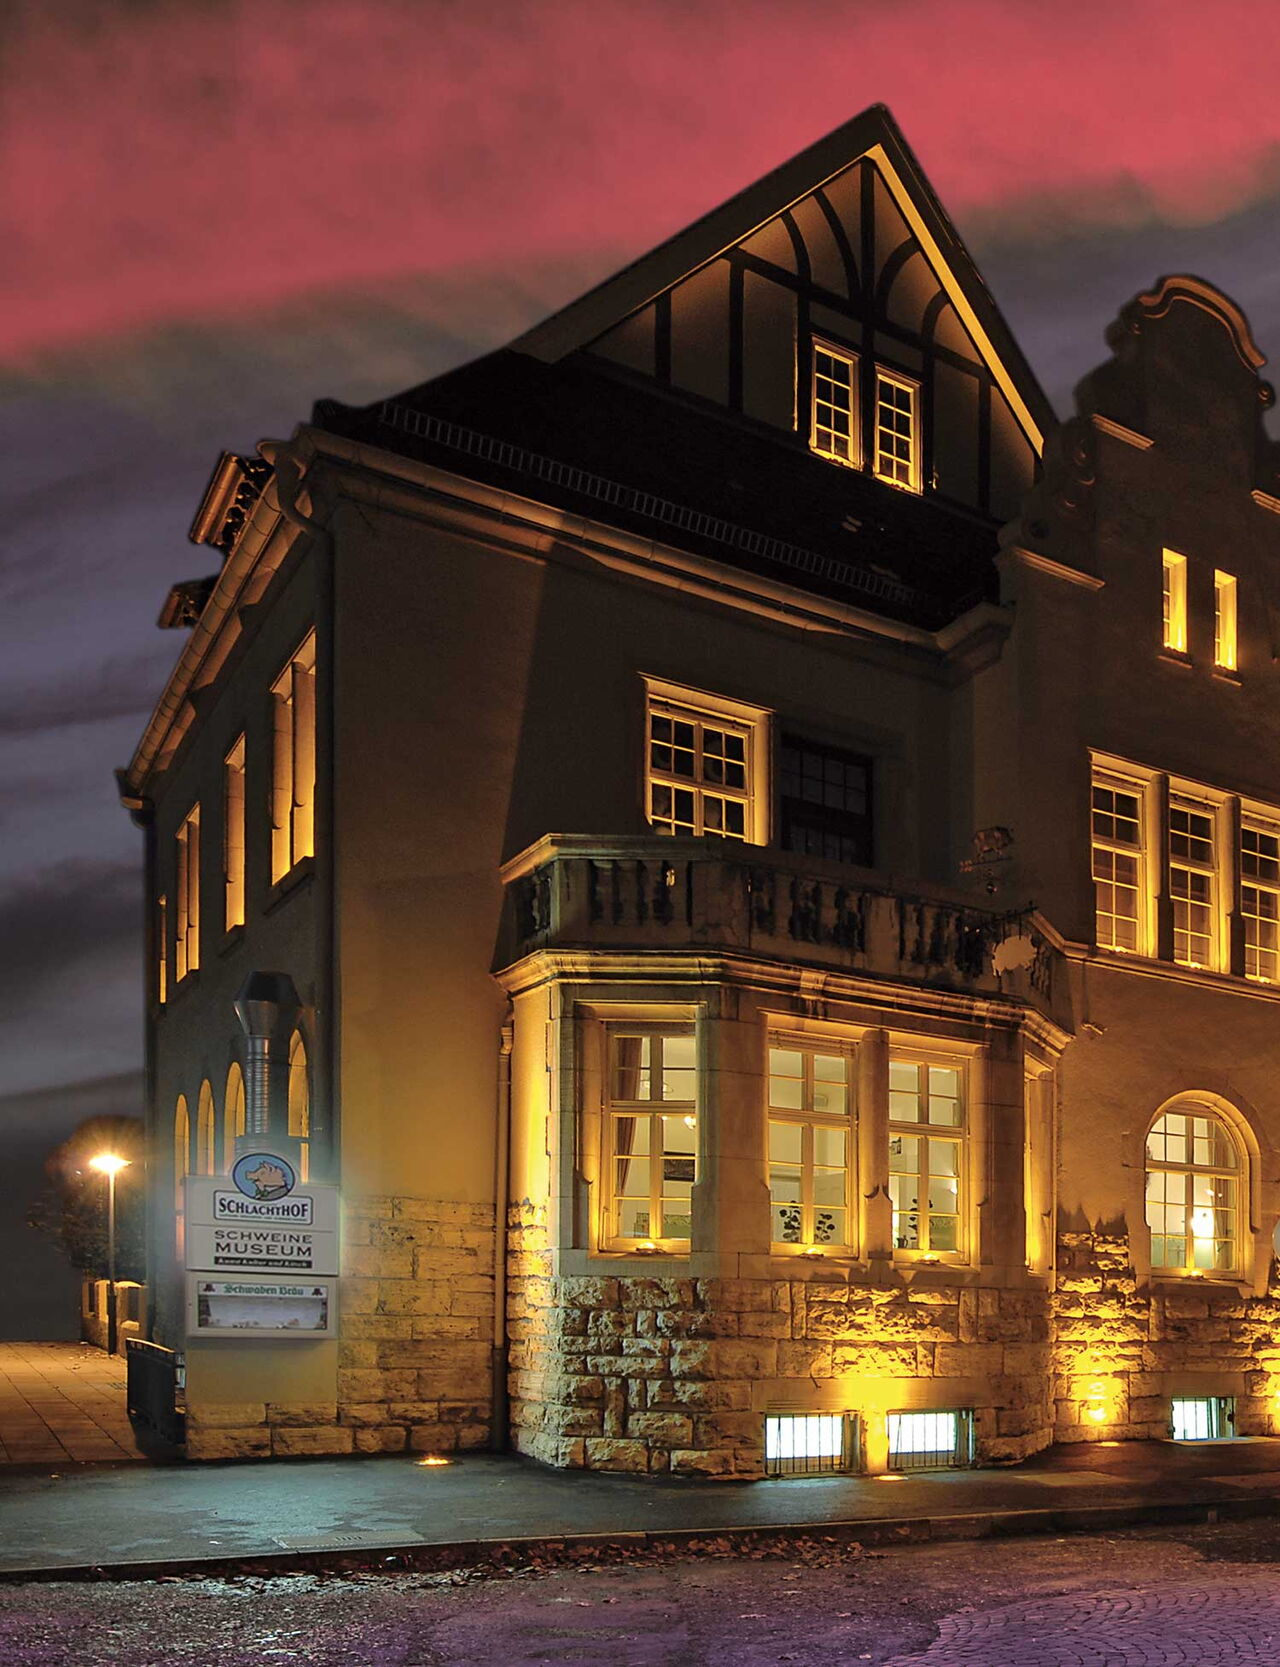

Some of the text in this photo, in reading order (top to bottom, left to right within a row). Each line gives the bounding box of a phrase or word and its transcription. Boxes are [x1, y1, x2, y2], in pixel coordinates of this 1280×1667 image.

[219, 1198, 308, 1217] SCHLACHTHOF
[215, 1230, 312, 1243] SCHWEINE
[216, 1243, 312, 1256] MUSEUM
[224, 1284, 276, 1294] Schwaben
